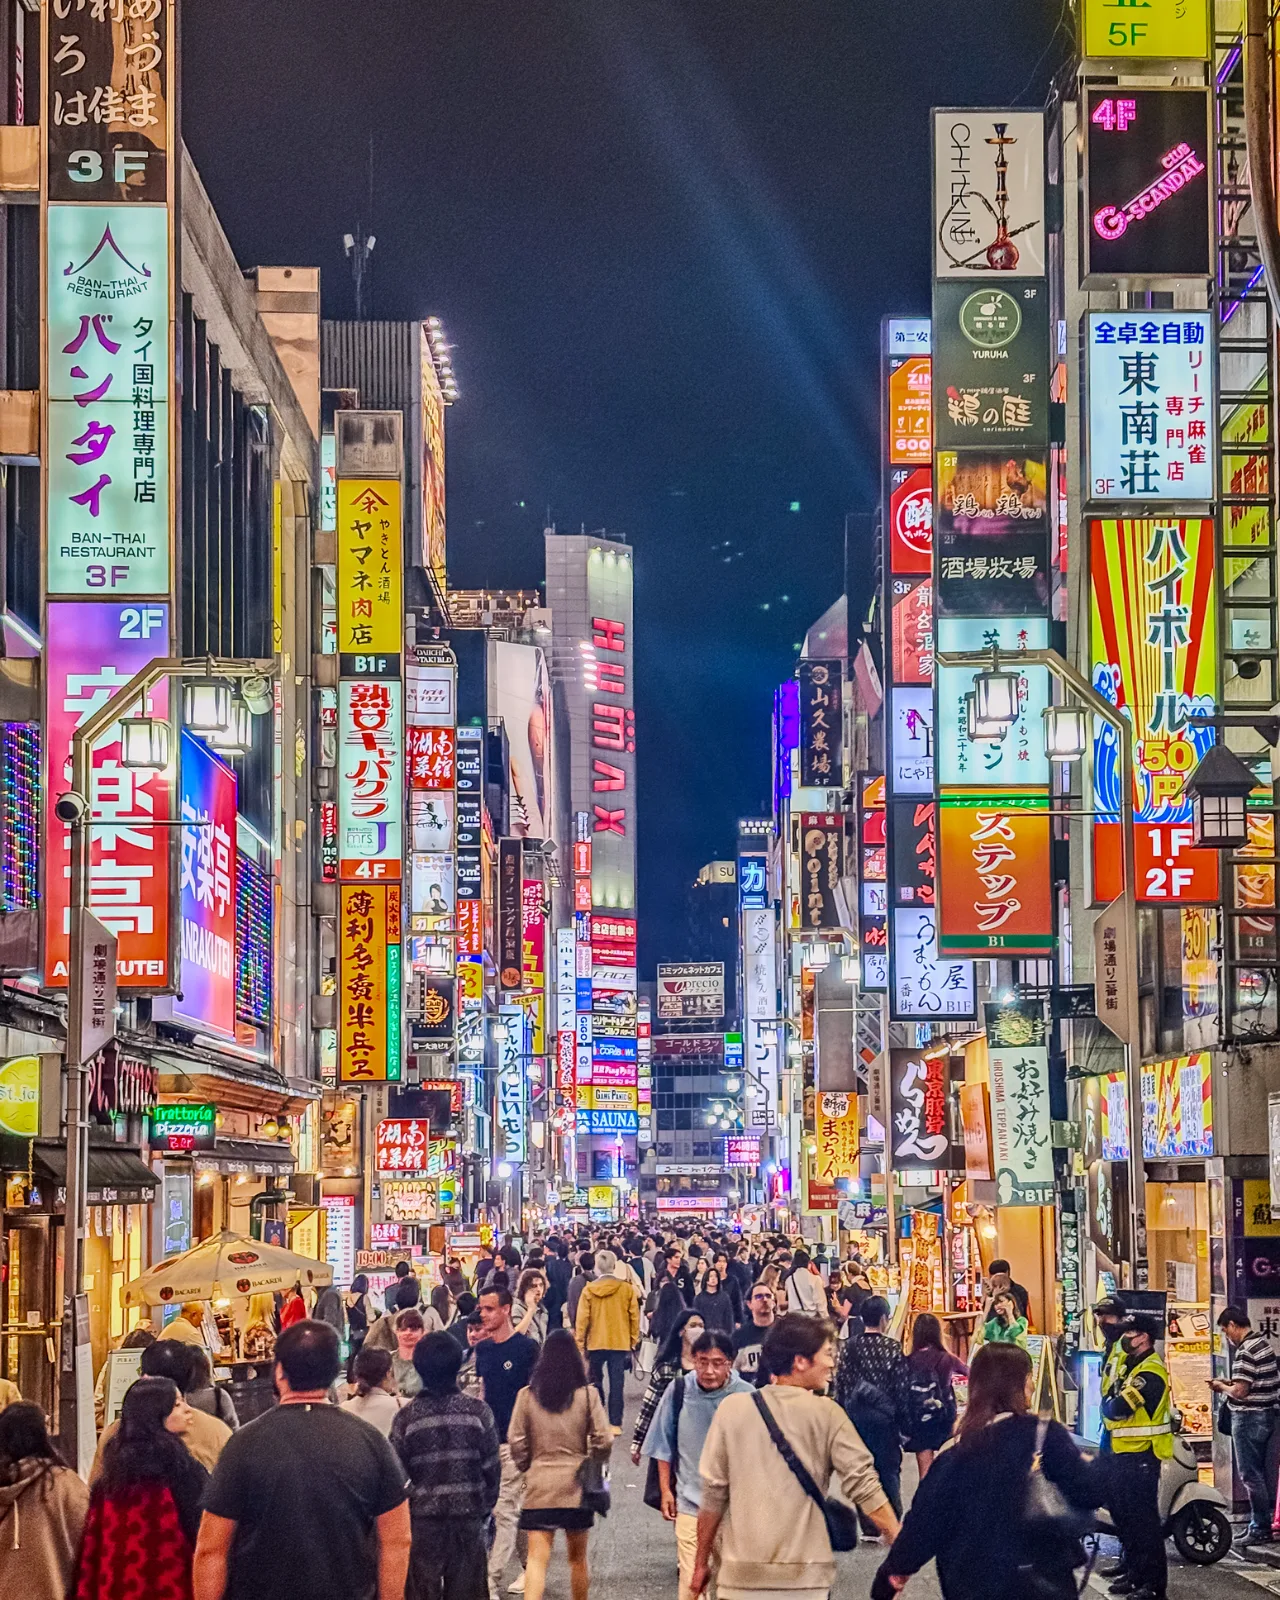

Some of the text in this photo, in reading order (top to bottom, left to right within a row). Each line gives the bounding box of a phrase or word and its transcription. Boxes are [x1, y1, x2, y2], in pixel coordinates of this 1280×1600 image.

[1108, 22, 1149, 46] 5F
[1092, 99, 1137, 131] 4F
[67, 150, 149, 183] 3F
[1161, 142, 1193, 169] CLUB
[66, 281, 149, 300] RESTAURANT
[77, 275, 138, 289] BAN-THAI
[1023, 289, 1037, 299] 3F
[1094, 321, 1205, 345] 全卓全自動
[972, 350, 1009, 359] YURUHA
[1022, 373, 1036, 383] 3F
[61, 313, 122, 517] バンタイ
[132, 316, 156, 504] タイ国料理専門店
[1186, 350, 1207, 465] リーチ麻雀
[1118, 350, 1162, 495] 東南荘
[1165, 396, 1185, 481] 専門店
[943, 457, 958, 467] 2F
[892, 471, 908, 483] 4F
[1094, 478, 1115, 495] 3F
[71, 532, 146, 544] BAN-THAI
[943, 535, 957, 545] 2F
[60, 546, 156, 558] RESTAURANT
[377, 518, 392, 605] やきとん酒場
[85, 565, 130, 587] 3F
[941, 555, 1038, 580] 酒場牧場
[348, 519, 374, 646] ヤマネ肉店
[892, 581, 912, 595] 3F
[119, 608, 164, 639] 2F
[1143, 526, 1192, 733] ハイボール
[354, 656, 387, 673] B1F
[1142, 740, 1194, 774] 50
[1151, 775, 1185, 808] 円
[807, 815, 835, 826] 麻雀
[354, 861, 387, 880] 4F
[969, 810, 1021, 932] ステップ
[1145, 868, 1195, 898] 2F
[987, 935, 1005, 947] B1
[940, 966, 969, 991] 屋
[1102, 927, 1119, 1011] 劇場通り一番街
[945, 1000, 972, 1012] B1F
[924, 1057, 945, 1134] 東京豚骨
[154, 1107, 213, 1121] Trattoria
[591, 1111, 637, 1127] SAUNA
[1011, 1057, 1049, 1170] お好み焼き
[1025, 1188, 1054, 1202] B1F
